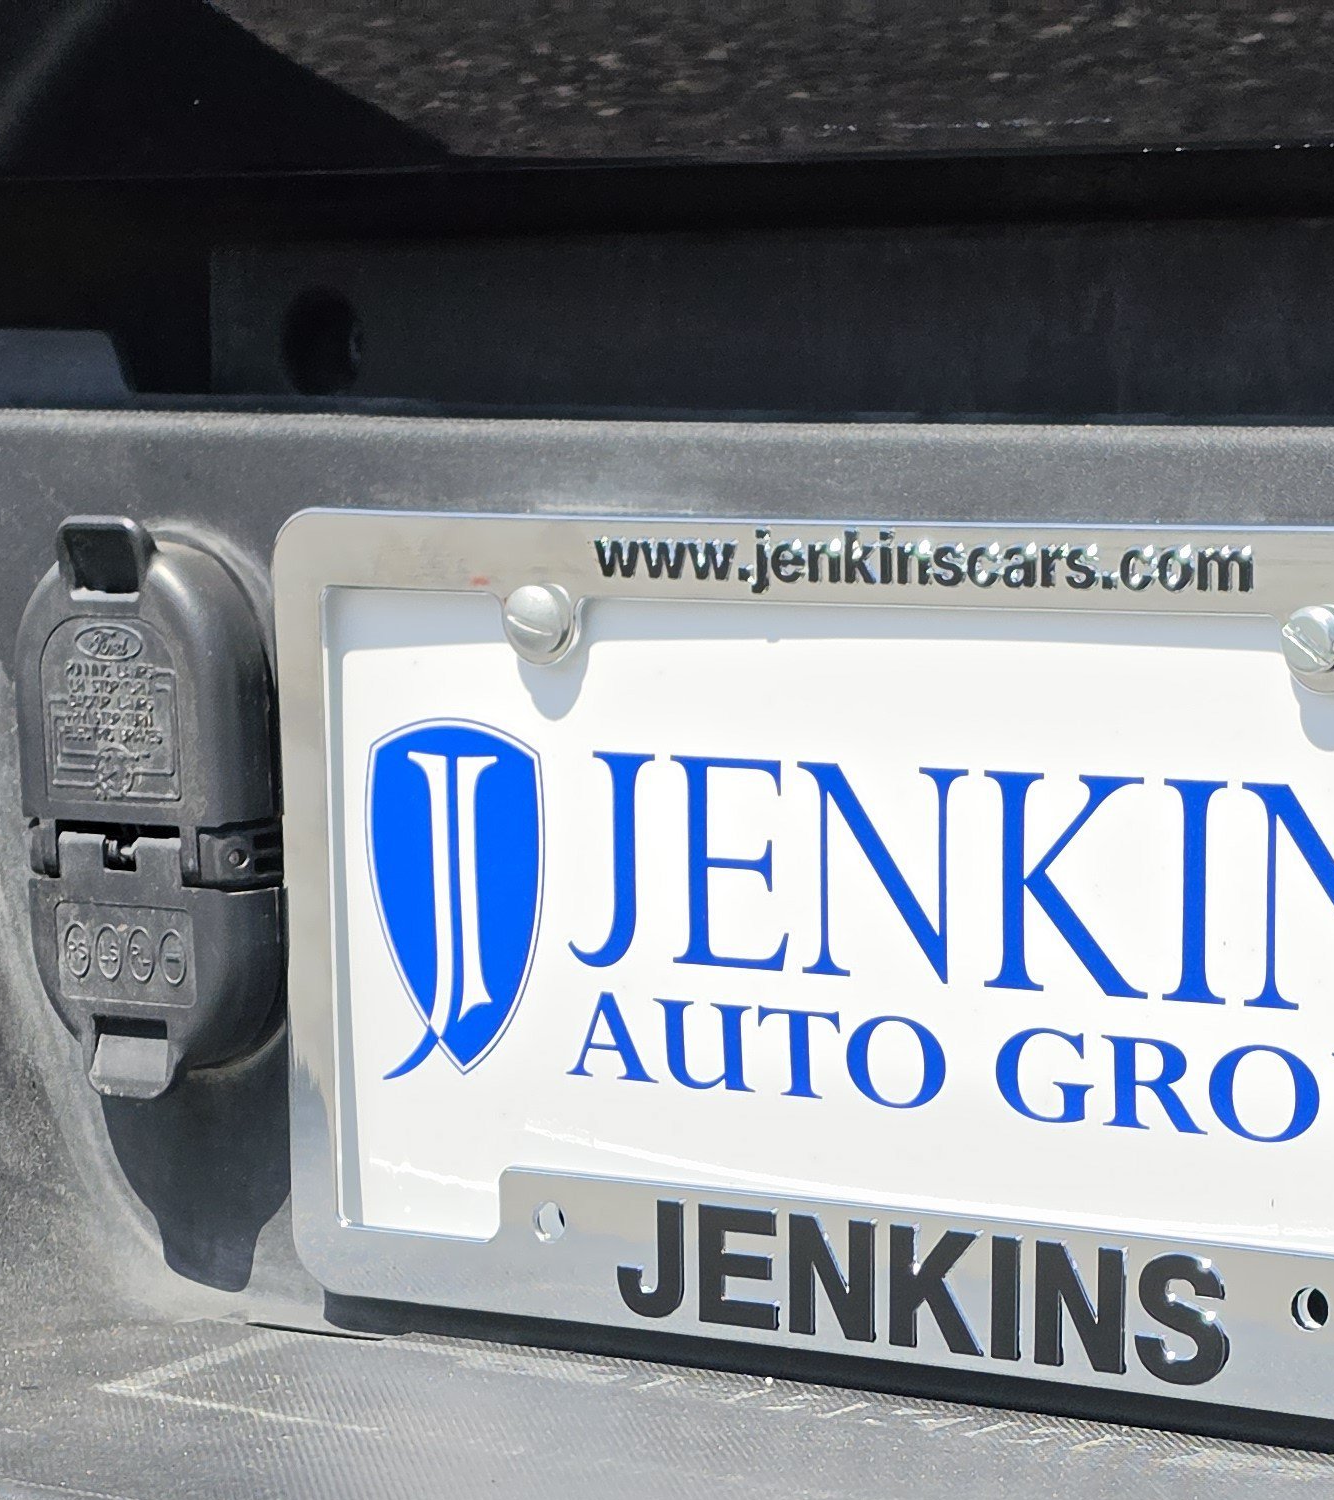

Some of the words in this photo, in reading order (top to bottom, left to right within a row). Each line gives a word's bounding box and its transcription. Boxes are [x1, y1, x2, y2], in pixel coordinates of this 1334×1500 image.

[594, 527, 1256, 594] www.jenkinscars.com
[568, 991, 948, 1109] AUTO
[616, 1198, 1231, 1386] JENKINS
